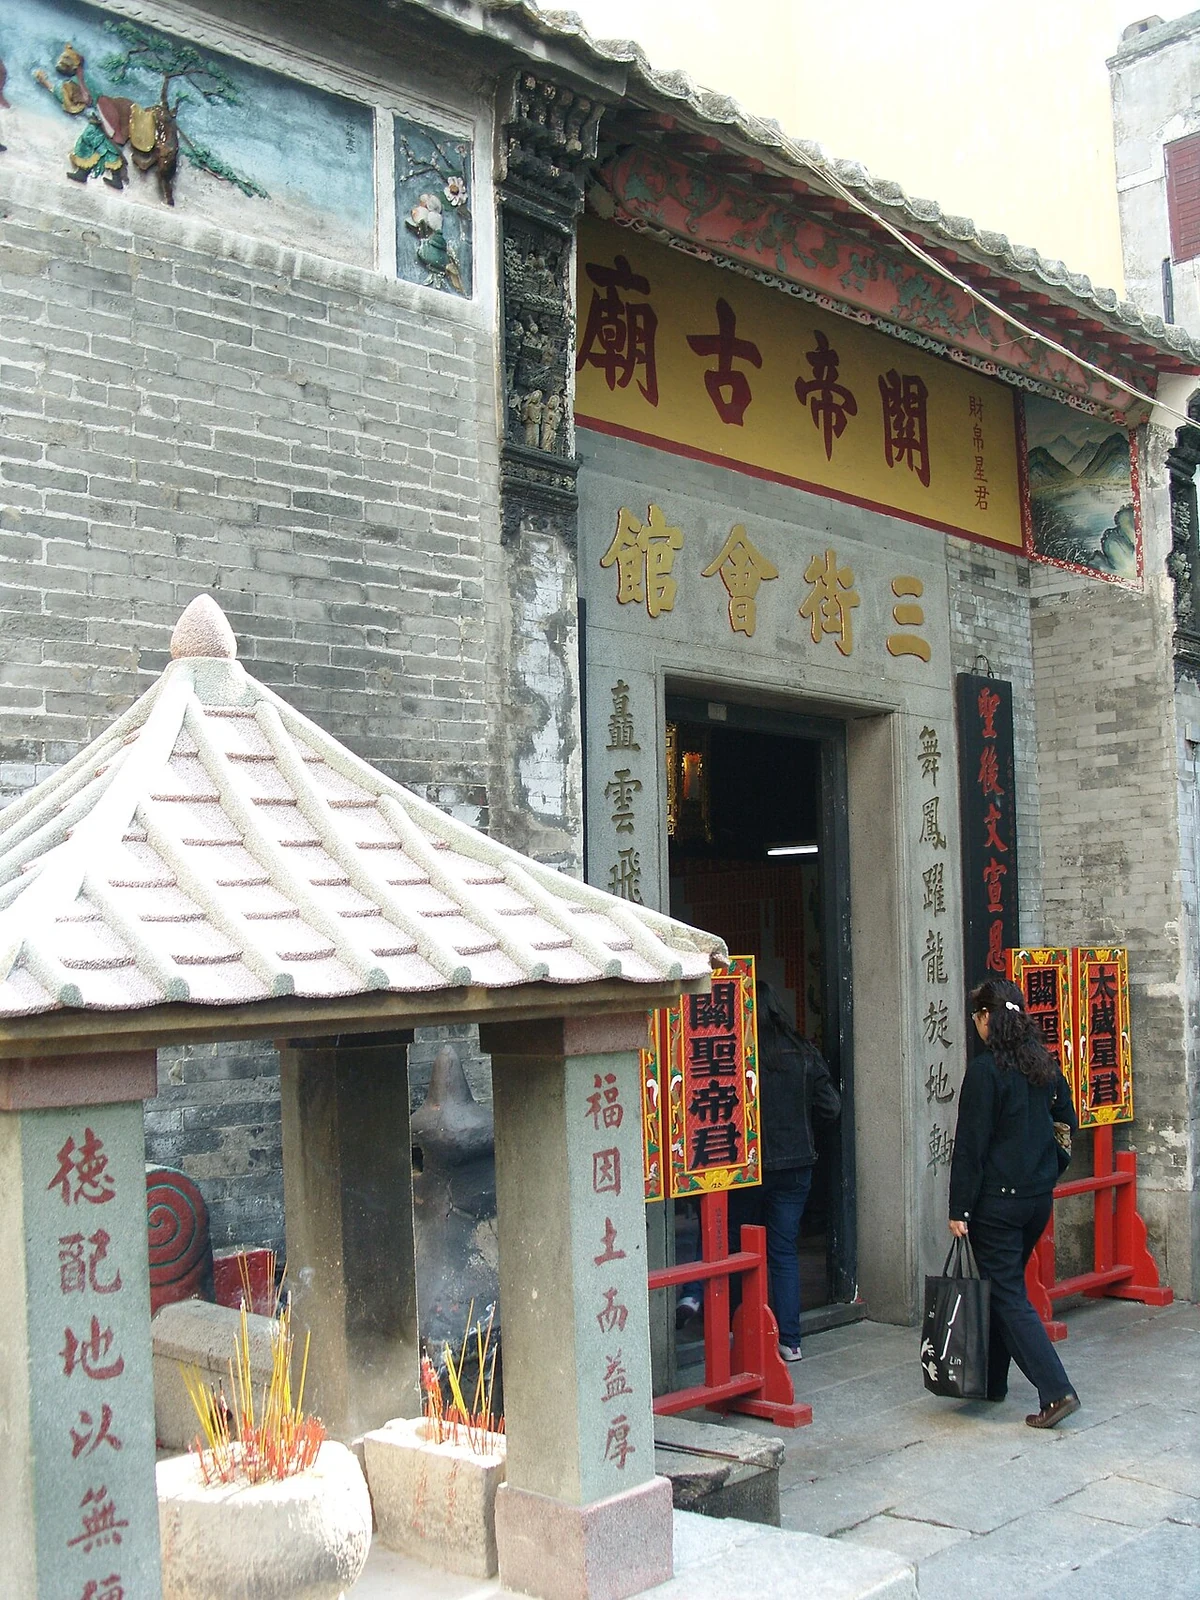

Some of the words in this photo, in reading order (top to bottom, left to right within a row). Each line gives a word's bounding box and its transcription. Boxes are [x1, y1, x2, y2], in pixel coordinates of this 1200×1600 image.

[968, 395, 989, 510] 財帛星君
[600, 503, 932, 664] 三街會館
[585, 1073, 637, 1471] 福因土而益厚
